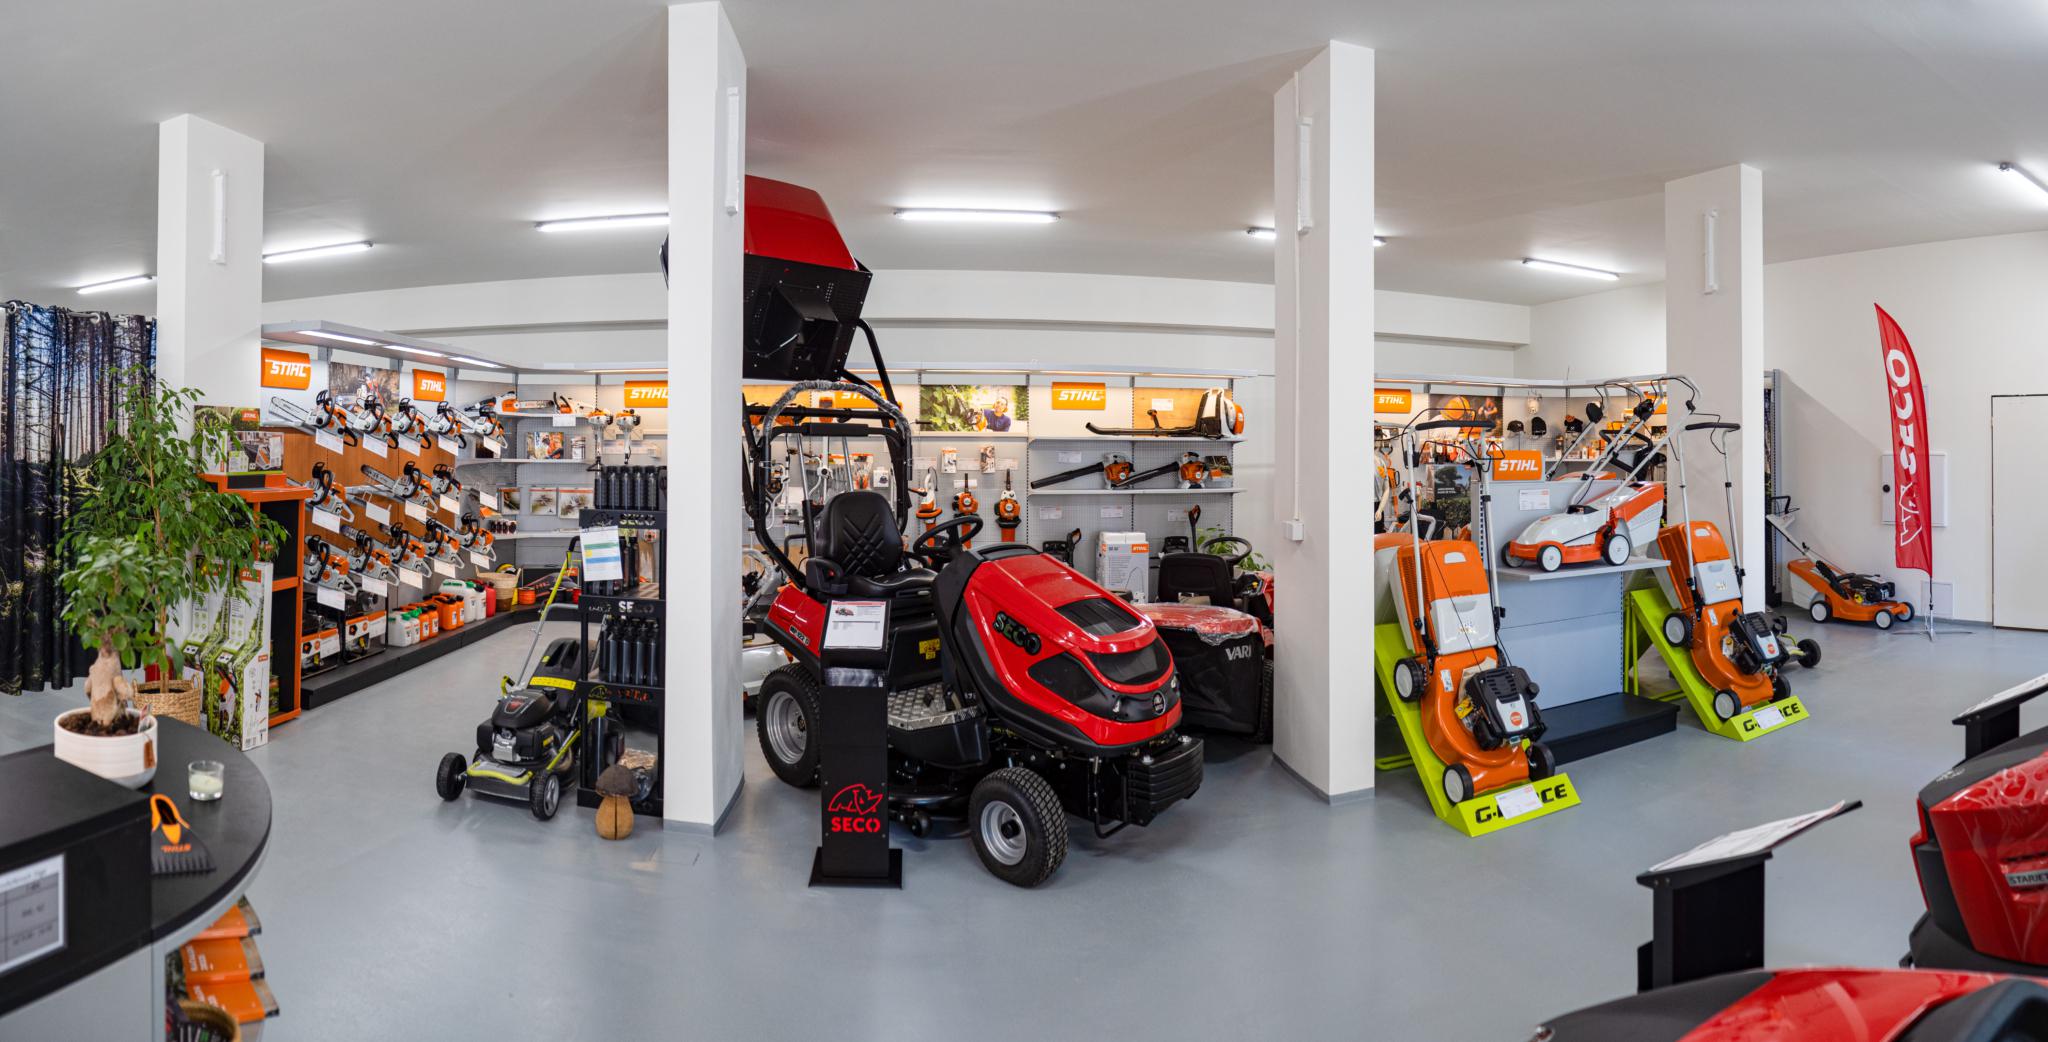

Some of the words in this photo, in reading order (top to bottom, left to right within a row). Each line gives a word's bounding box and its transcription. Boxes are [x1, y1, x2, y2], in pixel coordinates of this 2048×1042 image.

[270, 361, 307, 378] STIHL
[420, 379, 444, 392] STIHL
[630, 387, 669, 399] STIHL
[1058, 389, 1101, 401] STIHL
[1378, 396, 1405, 405] STIHL
[1886, 348, 1917, 475] SECO
[1499, 459, 1539, 472] STIHL
[993, 611, 1042, 656] SECO
[1225, 644, 1252, 661] VARI
[1743, 702, 1801, 732] G-CE
[1474, 783, 1568, 825] G-CE
[831, 816, 881, 833] SECO
